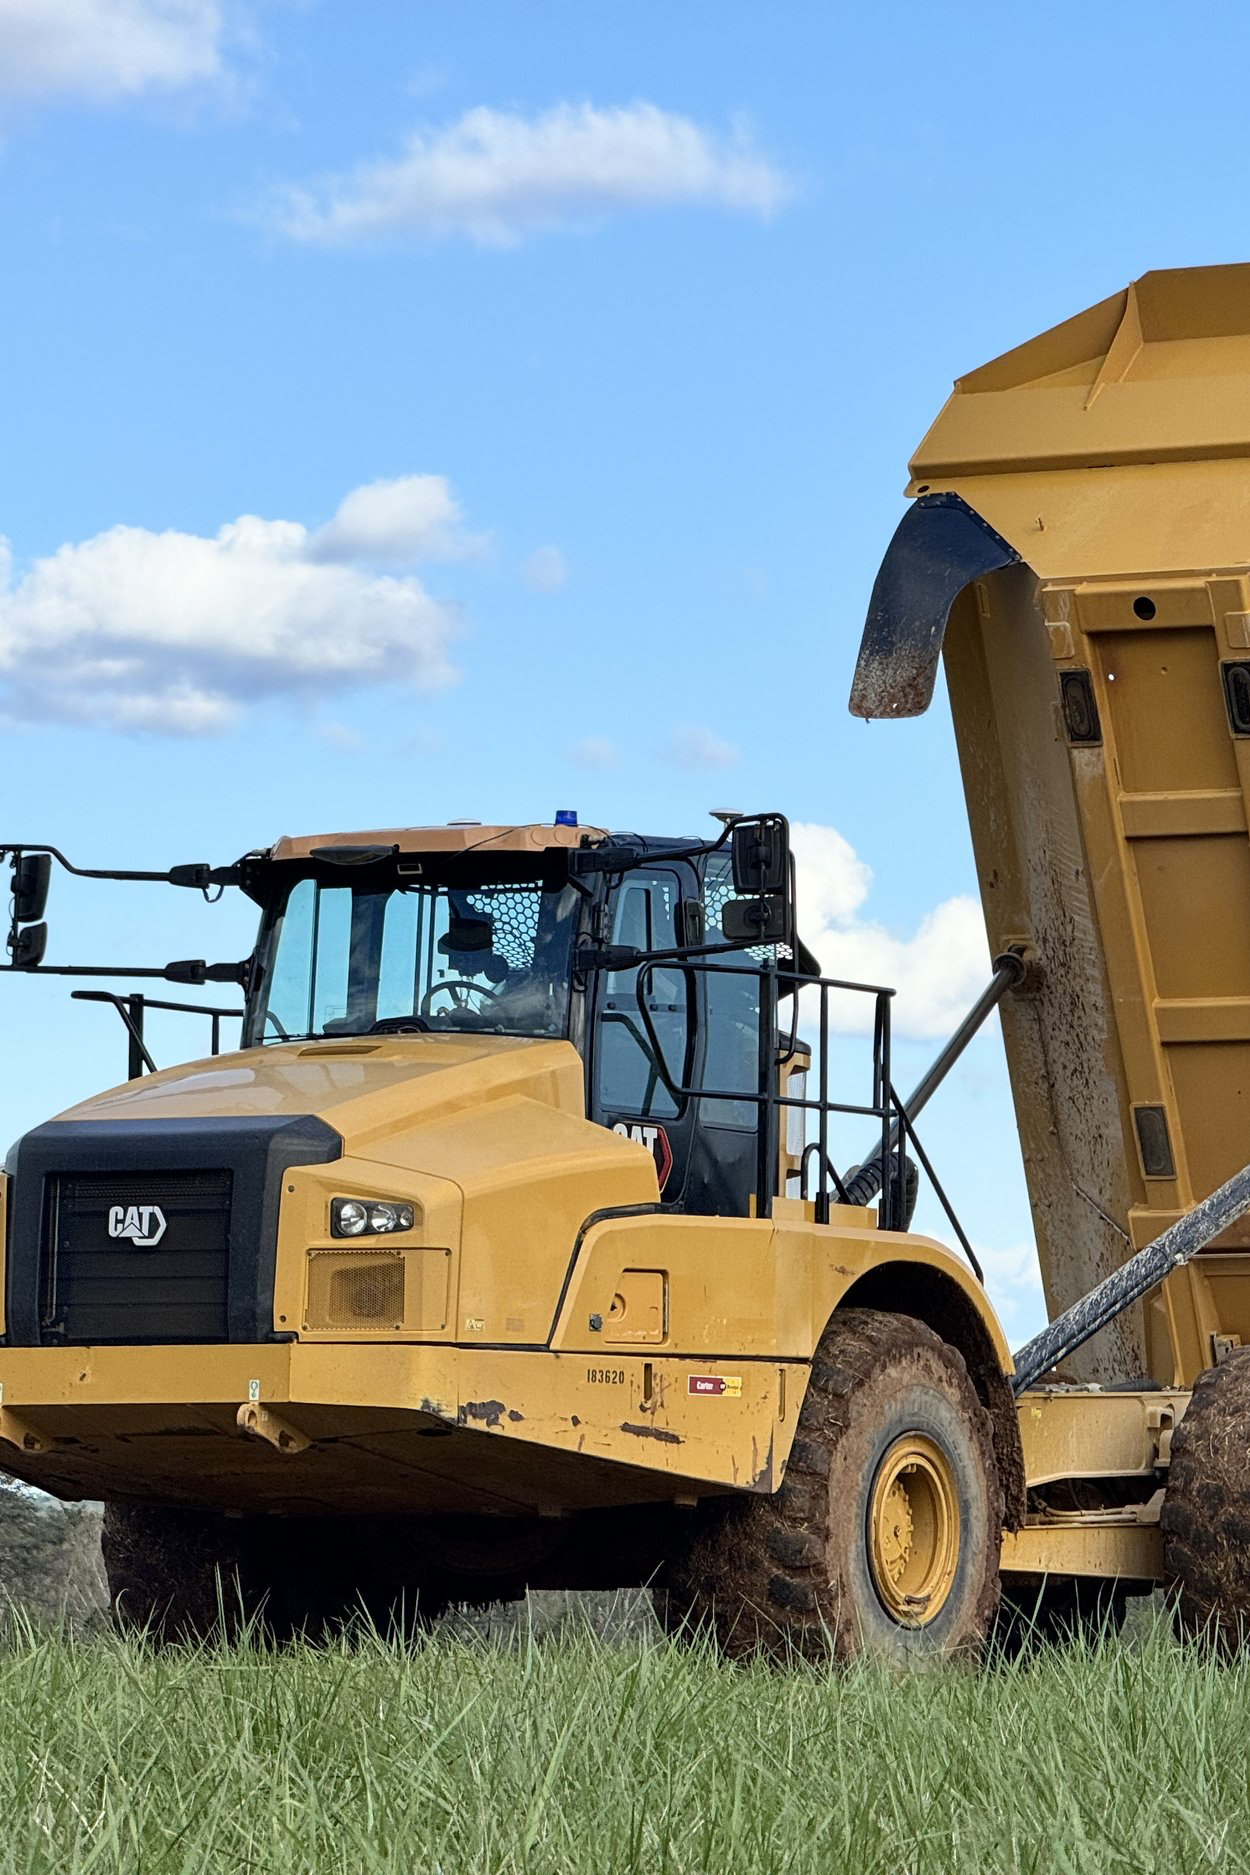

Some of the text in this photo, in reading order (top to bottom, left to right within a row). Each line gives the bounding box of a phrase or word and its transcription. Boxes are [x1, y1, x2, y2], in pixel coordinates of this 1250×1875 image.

[612, 1123, 658, 1155] AT
[108, 1205, 156, 1238] CAT
[586, 1368, 625, 1385] 183620
